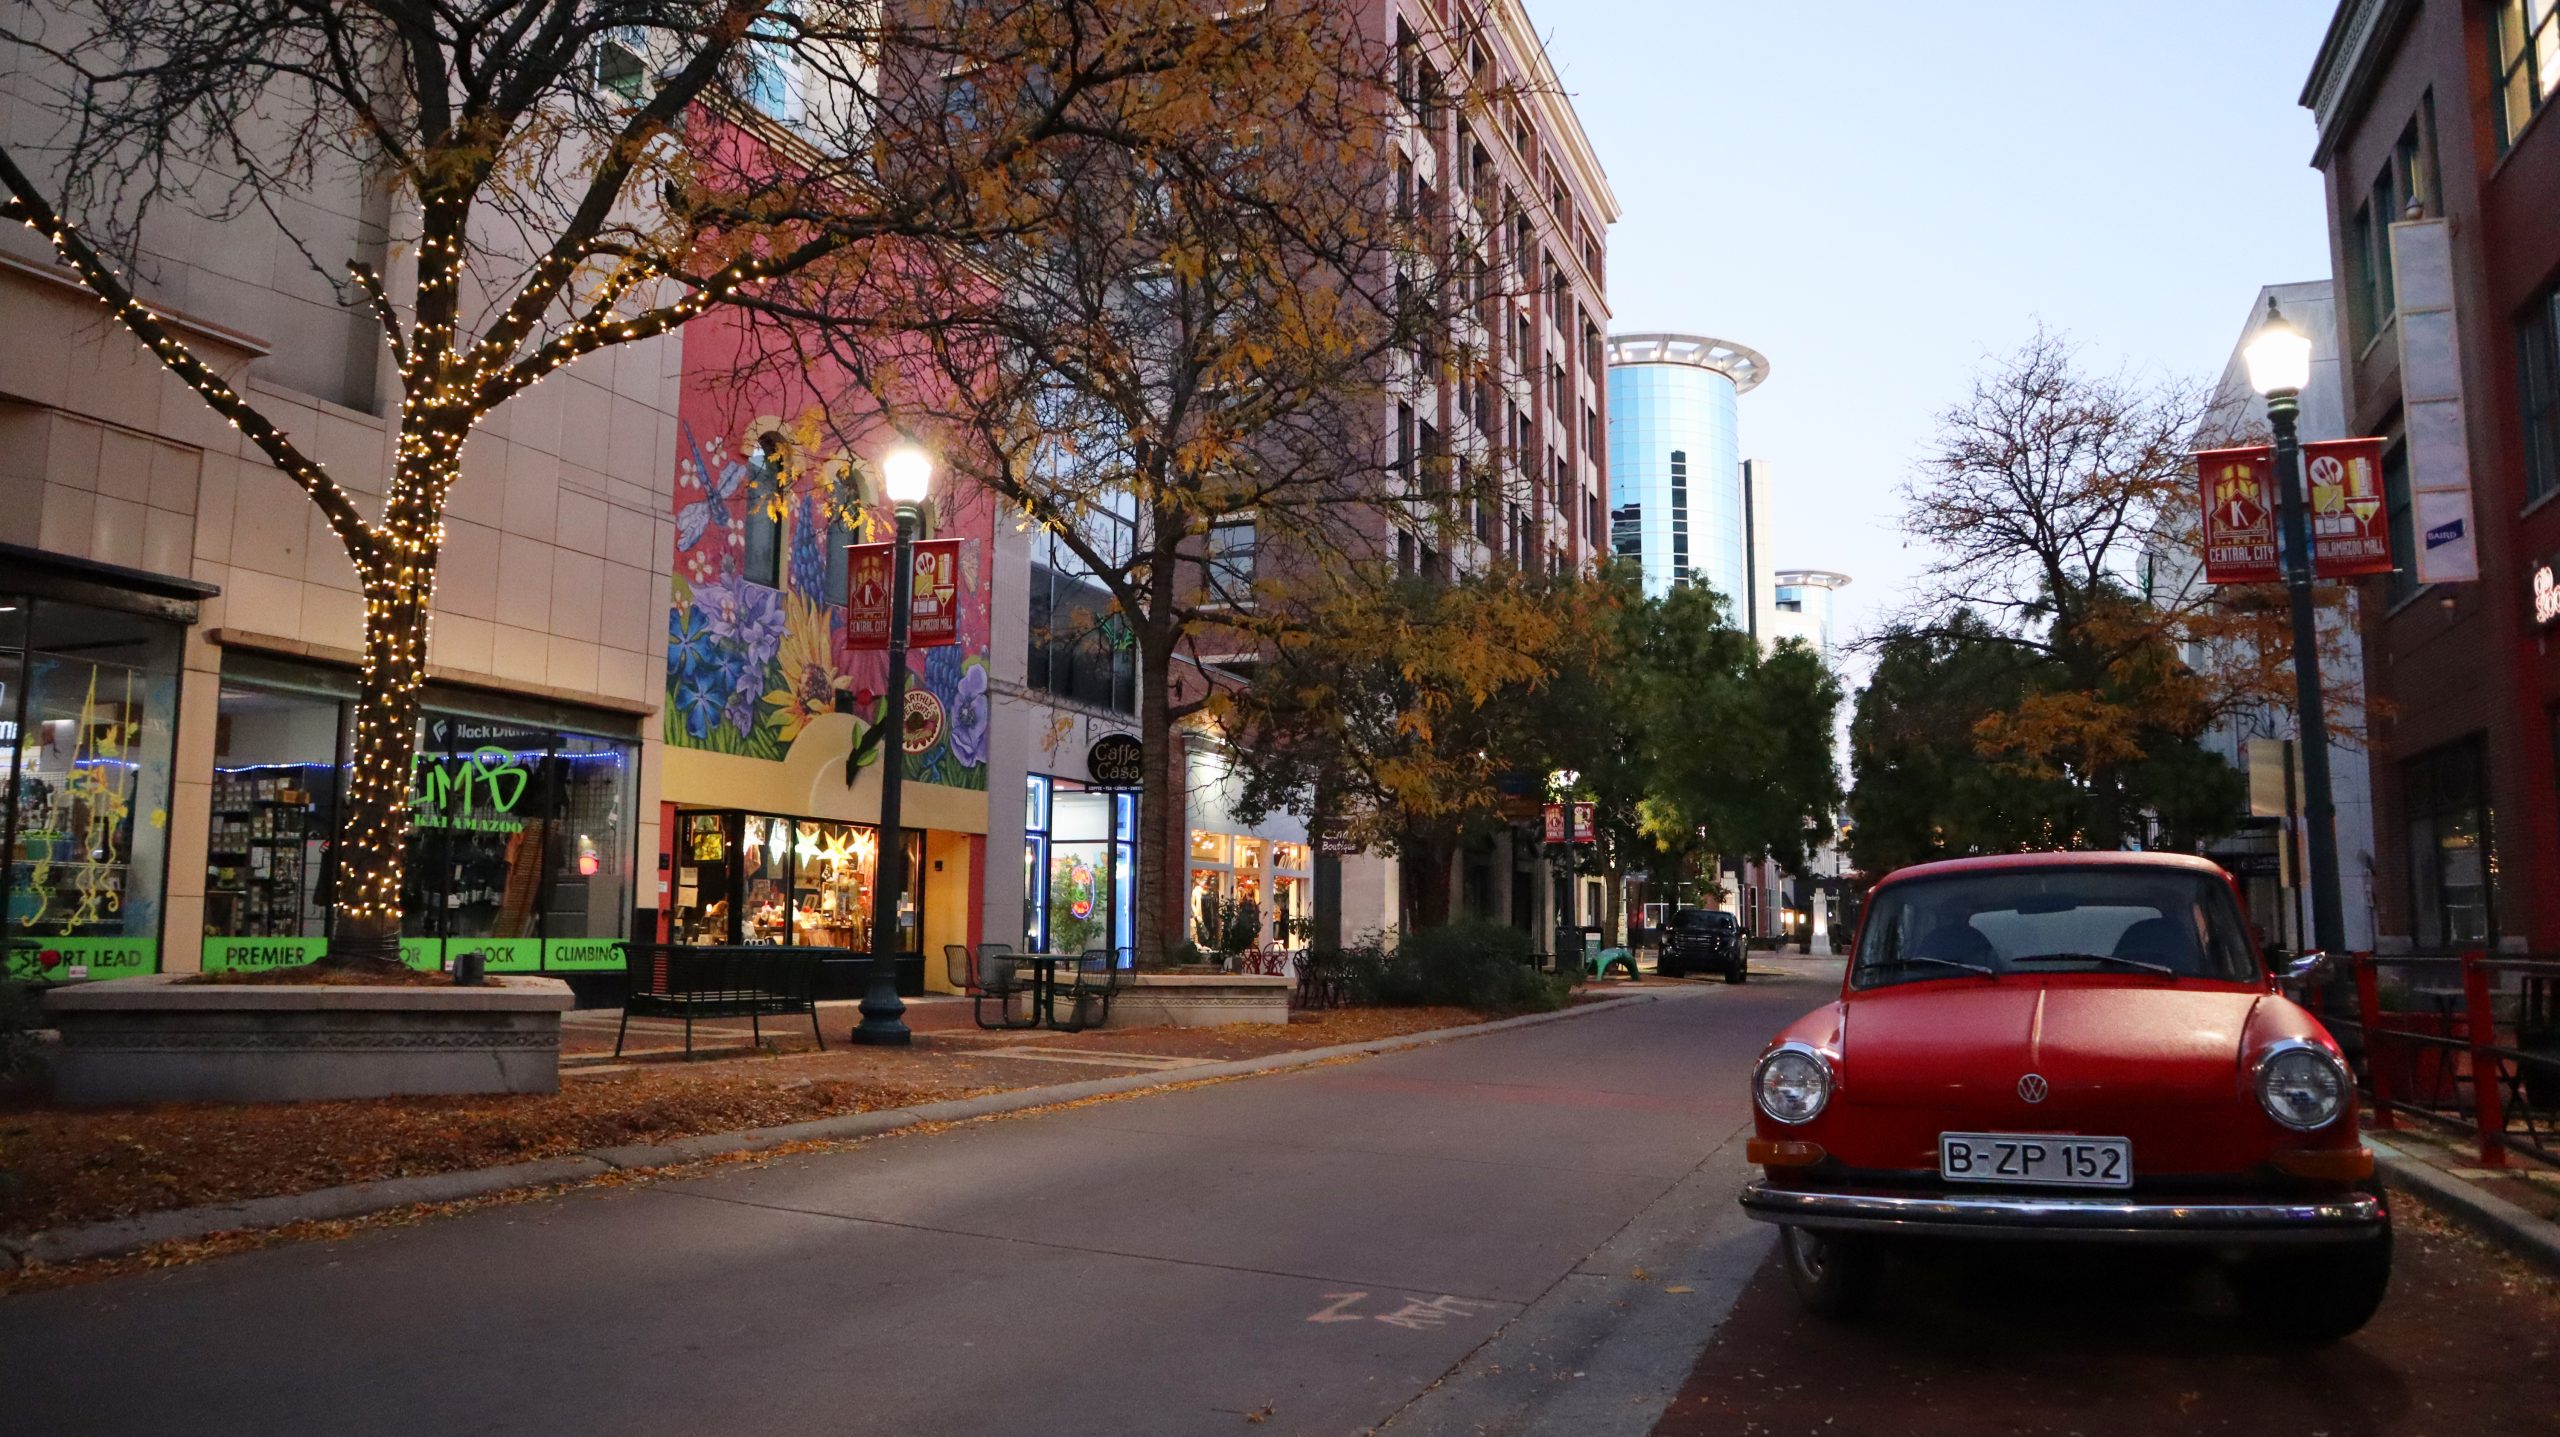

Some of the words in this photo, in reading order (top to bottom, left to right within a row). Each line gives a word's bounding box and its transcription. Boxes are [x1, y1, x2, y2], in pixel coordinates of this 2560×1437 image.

[2231, 500, 2249, 527] K
[2427, 531, 2457, 541] BAIRD
[2209, 546, 2252, 563] CENTRAL
[2254, 544, 2275, 560] CITY
[2316, 540, 2362, 557] KALAMAZOO
[2364, 537, 2386, 555] MALL
[850, 620, 874, 633] CENTRAL
[875, 620, 888, 632] CITY
[903, 703, 931, 718] ELIGHTS
[1095, 743, 1140, 765] Caffe
[1097, 762, 1139, 779] Casa
[414, 813, 522, 834] KALAMAZOO
[1321, 840, 1357, 853] Boutique
[93, 950, 142, 968] LEAD
[225, 946, 305, 966] PREMIER
[555, 945, 619, 963] CLIMBING
[1949, 1142, 2046, 1175] B-ZP
[2062, 1145, 2121, 1179] 152
